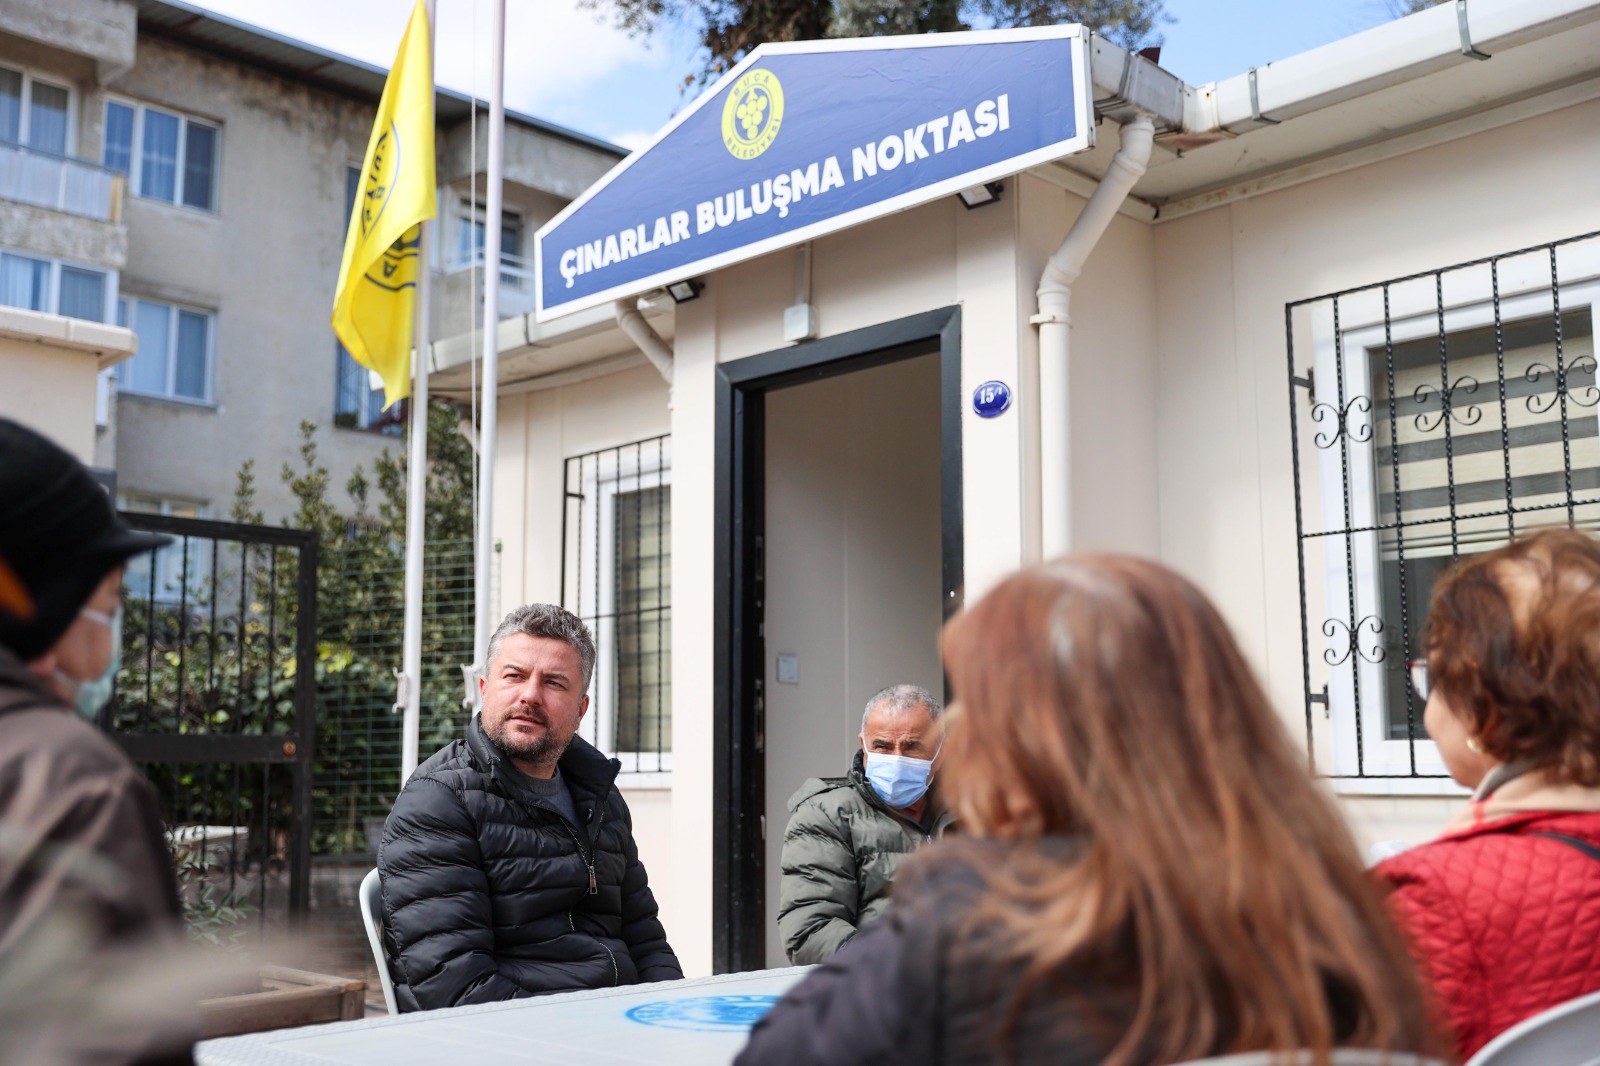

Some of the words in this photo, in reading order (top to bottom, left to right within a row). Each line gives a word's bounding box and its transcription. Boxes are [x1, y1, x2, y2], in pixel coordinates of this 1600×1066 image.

[733, 72, 770, 97] BUCA
[559, 210, 690, 288] ÇINARLAR
[696, 156, 845, 235] BULUŞMA
[852, 93, 1010, 182] NOKTASI
